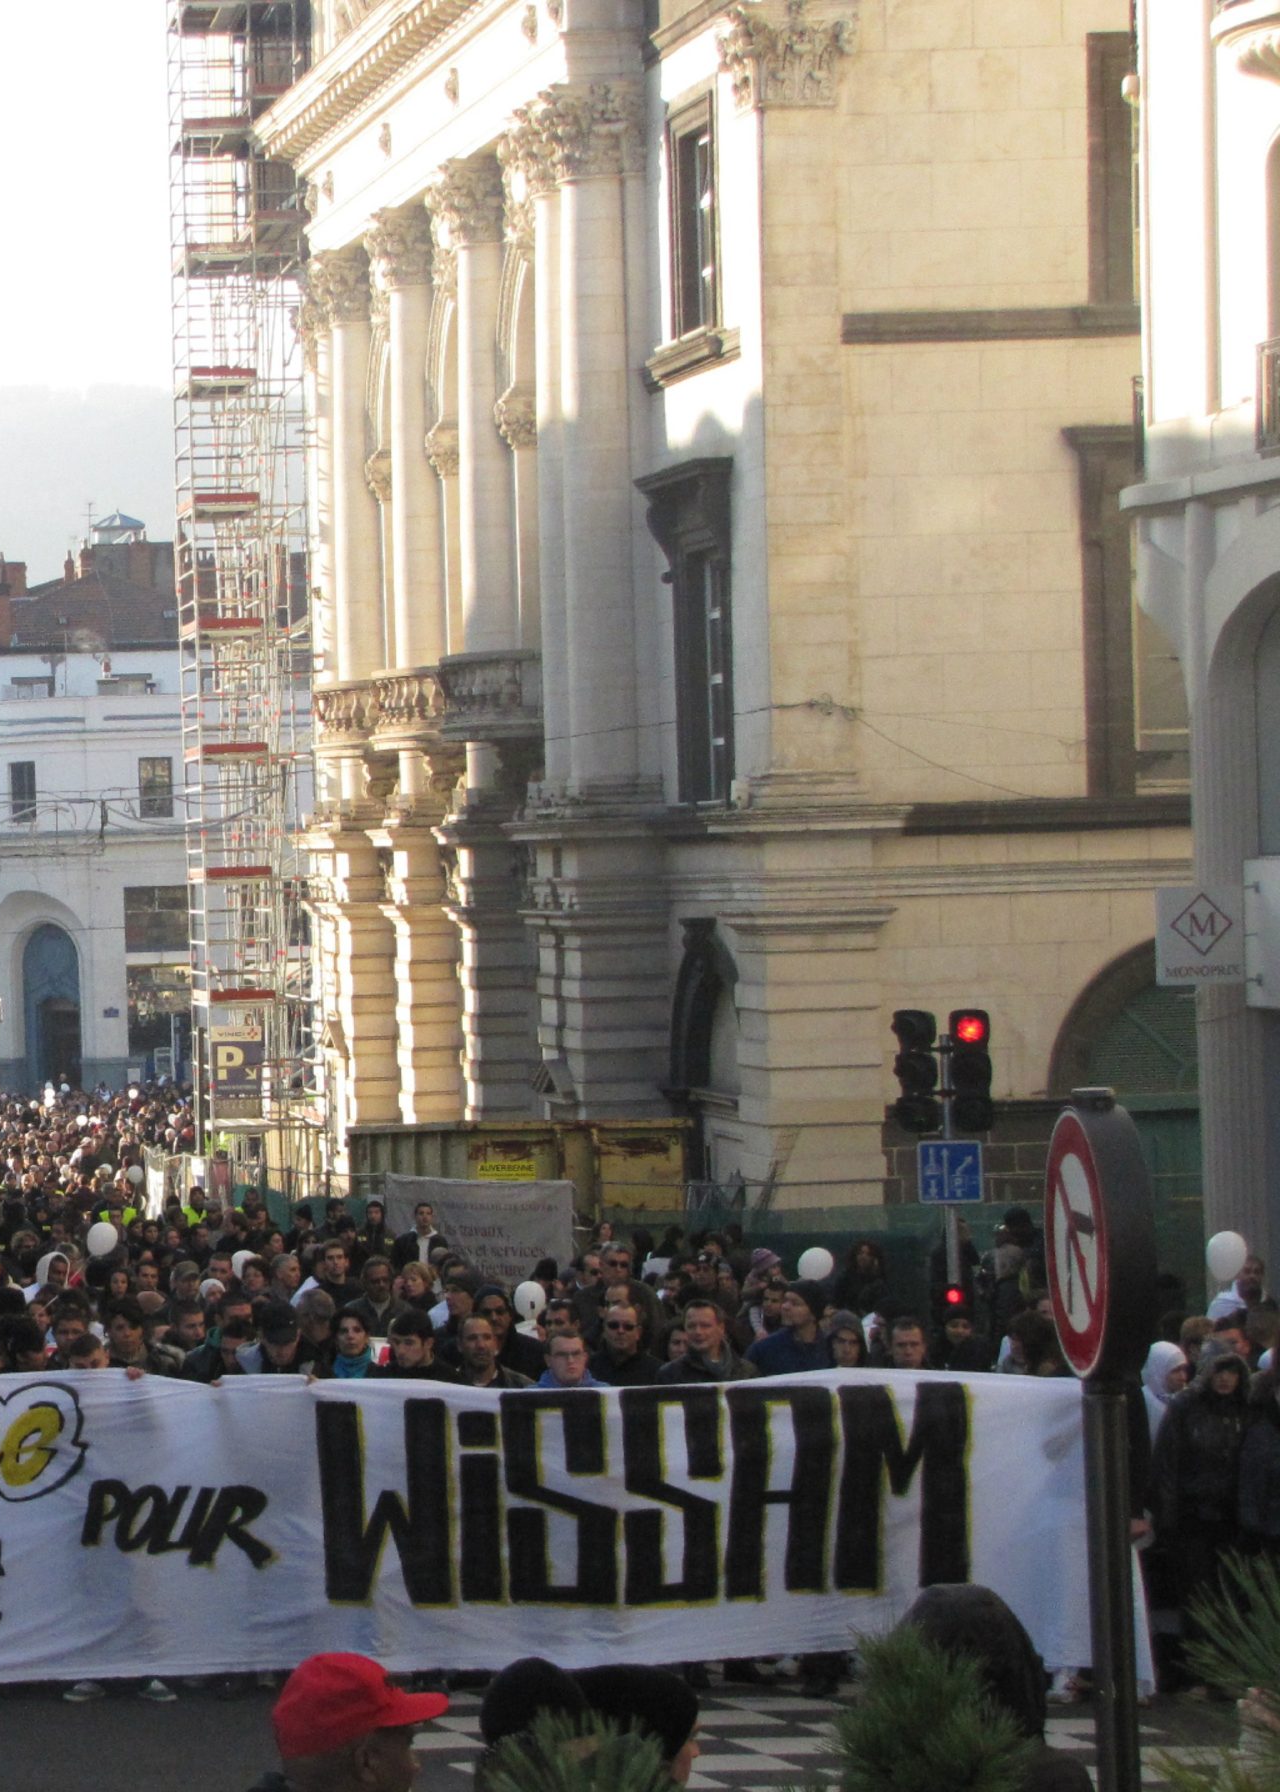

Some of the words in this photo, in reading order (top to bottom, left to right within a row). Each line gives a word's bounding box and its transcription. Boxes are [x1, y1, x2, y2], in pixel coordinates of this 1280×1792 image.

[1188, 911, 1217, 936] M
[1165, 965, 1241, 977] MONOPRIX
[217, 1046, 244, 1080] P
[81, 1480, 280, 1570] POUR
